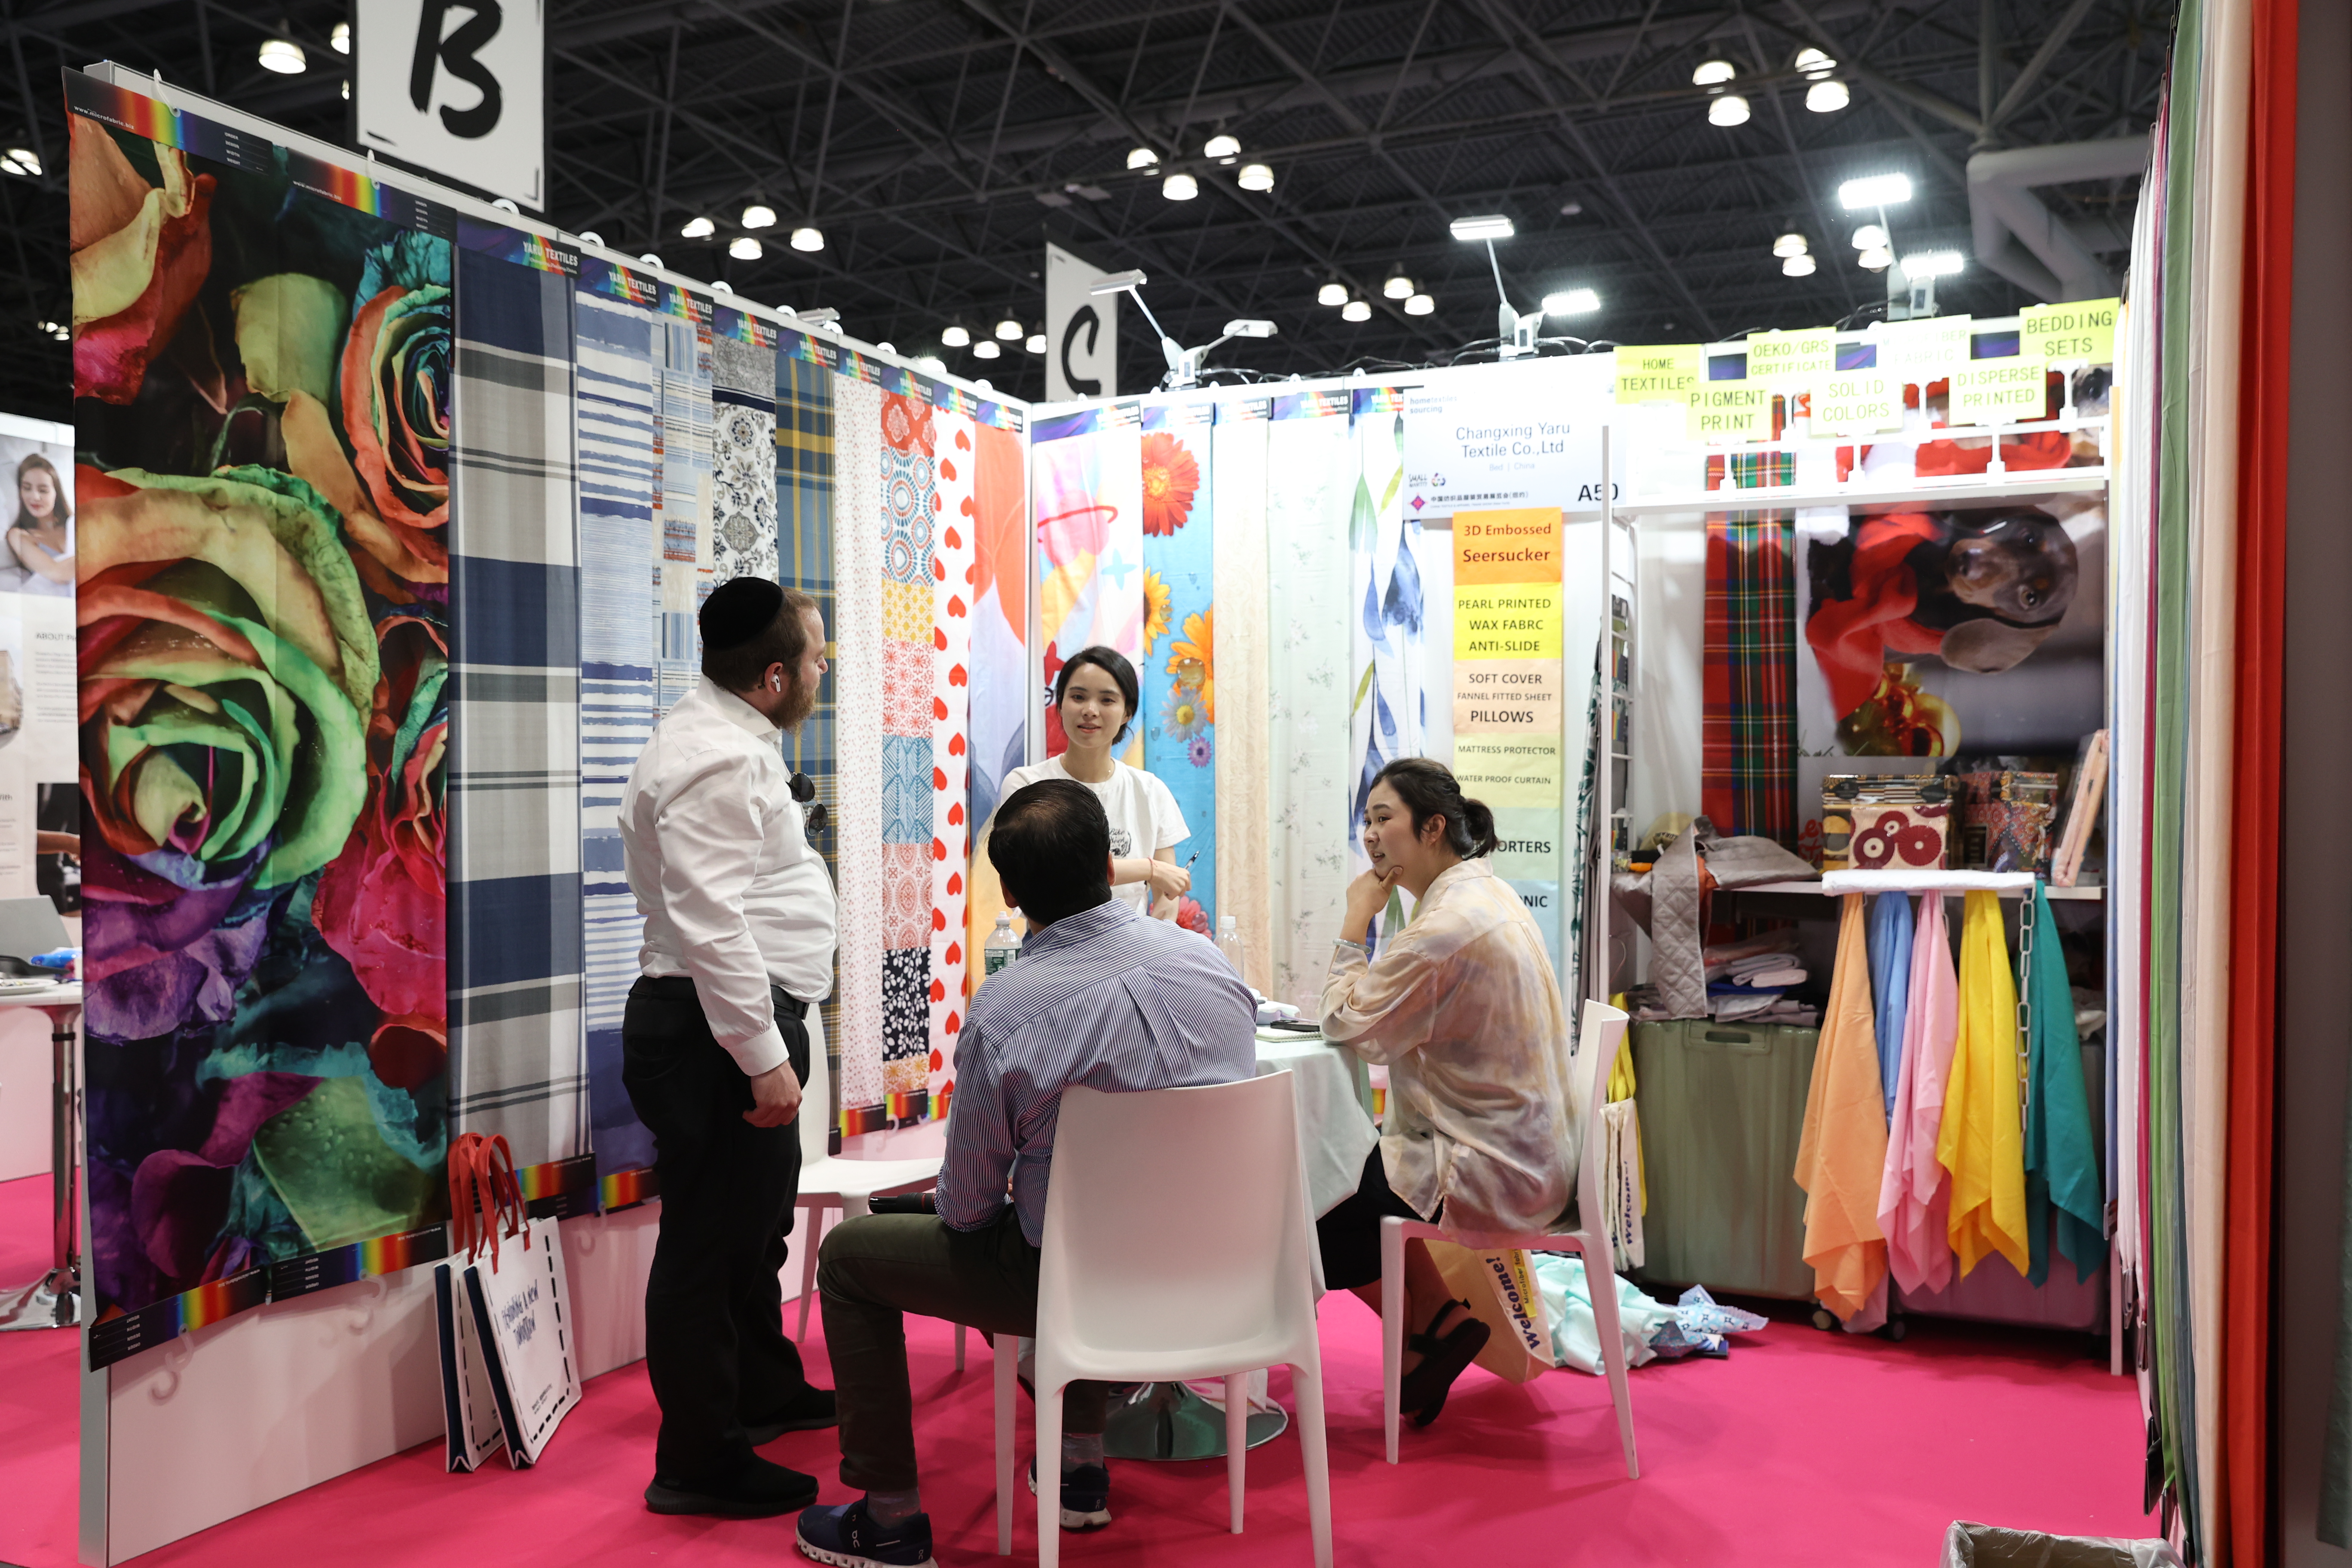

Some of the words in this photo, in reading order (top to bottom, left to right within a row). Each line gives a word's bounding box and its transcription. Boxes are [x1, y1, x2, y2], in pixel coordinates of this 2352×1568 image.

[410, 0, 504, 139] B
[74, 106, 134, 130] www.microfabric.biz
[523, 241, 542, 256] YARU
[545, 247, 578, 266] TEXTILES
[608, 271, 625, 285] YARU
[627, 278, 657, 295] TEXTILES
[668, 292, 685, 306] YARU
[686, 297, 713, 315] TEXTILES
[2027, 311, 2112, 334] BEDDING
[753, 323, 777, 339] TEXTILES
[814, 345, 837, 360] TEXTILES
[1062, 304, 1101, 395] C
[1754, 340, 1829, 357] OEKO/GRS
[2045, 338, 2092, 356] SETS
[1643, 358, 1674, 369] HOME
[1895, 349, 1953, 364] FABRIC
[1751, 360, 1831, 375] CERTIFICATE
[1957, 366, 2040, 386] DISPERSE
[1829, 380, 1883, 398] SOLID
[1390, 393, 1403, 403] TEX
[1410, 395, 1457, 405] hometextiles
[1691, 390, 1765, 407] PIGMENT
[1963, 389, 2035, 407] PRINTED
[1410, 406, 1442, 414] sourcing
[1823, 403, 1890, 422] COLORS
[1702, 414, 1754, 430] PRINT
[1456, 424, 1532, 441] Changxing
[1538, 423, 1570, 435] Yaru
[1461, 443, 1507, 458] Textile
[1512, 440, 1564, 456] Co.,Ltd
[1489, 463, 1504, 472] Bed
[1514, 462, 1535, 470] China
[1577, 483, 1618, 502] A50
[1464, 526, 1481, 536] 3D
[1486, 523, 1551, 535] Embossed
[1463, 548, 1550, 562] Seersucker
[1459, 600, 1494, 609] PEARL
[1498, 599, 1551, 608] PRINTED
[1470, 620, 1498, 630] WAX
[1503, 620, 1543, 630] FABRC
[1469, 641, 1540, 651] ANTI-SLIDE
[1469, 674, 1498, 683] SOFT
[1502, 674, 1543, 684] COVER
[1458, 692, 1489, 701] FANNEL
[1470, 710, 1533, 723] PILLOWS
[1458, 745, 1501, 754] MATTRESS
[1504, 746, 1556, 755] PROTECTOR
[1514, 776, 1551, 784] CURTAIN
[1498, 840, 1551, 853] ORTERS
[1519, 895, 1549, 907] NIC
[1623, 1161, 1632, 1244] welcom!
[1512, 1249, 1520, 1265] fabri
[1485, 1256, 1540, 1350] welcome!
